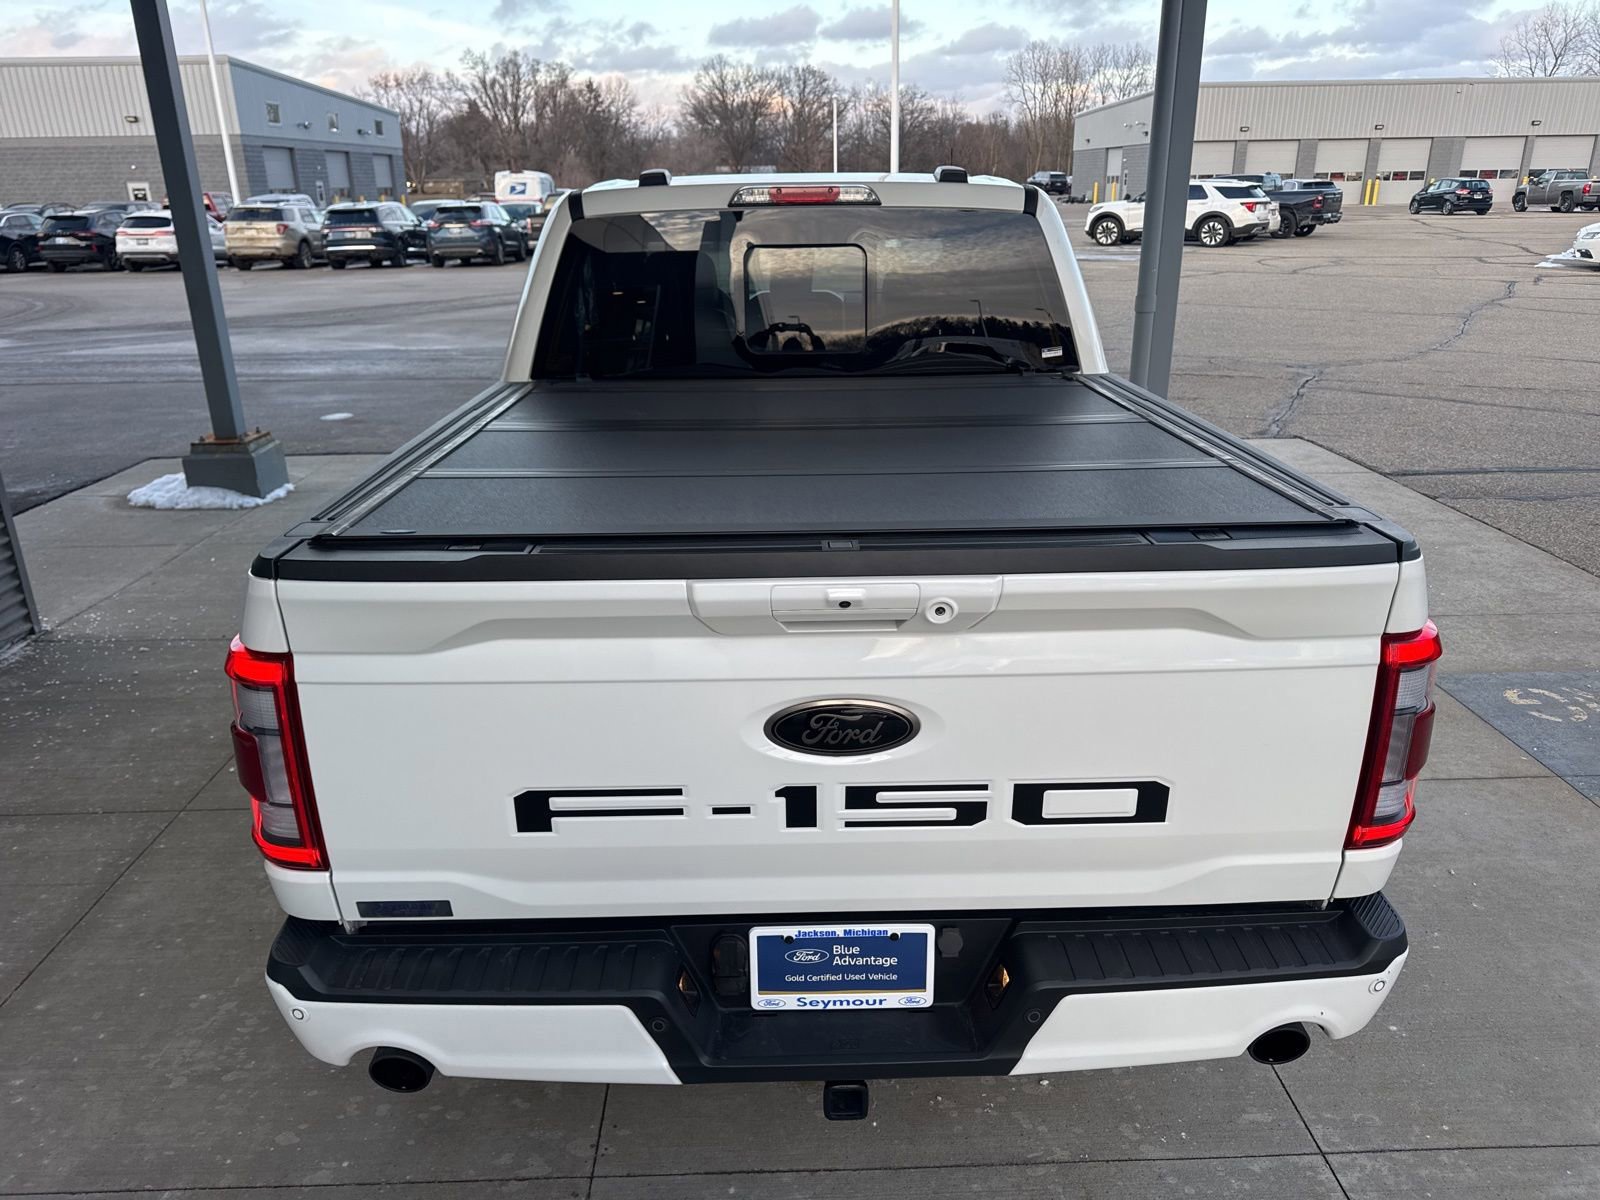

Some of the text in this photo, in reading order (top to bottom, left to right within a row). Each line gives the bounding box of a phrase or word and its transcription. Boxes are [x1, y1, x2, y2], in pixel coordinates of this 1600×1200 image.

[801, 713, 884, 745] Ford
[513, 780, 1171, 834] F-150
[794, 928, 888, 938] Jackson, Michigan
[833, 944, 860, 955] Blue
[793, 950, 821, 962] Ford
[833, 955, 898, 967] Advantage
[785, 972, 898, 982] Gold Certified Used Vehicle
[796, 997, 887, 1009] Seymour
